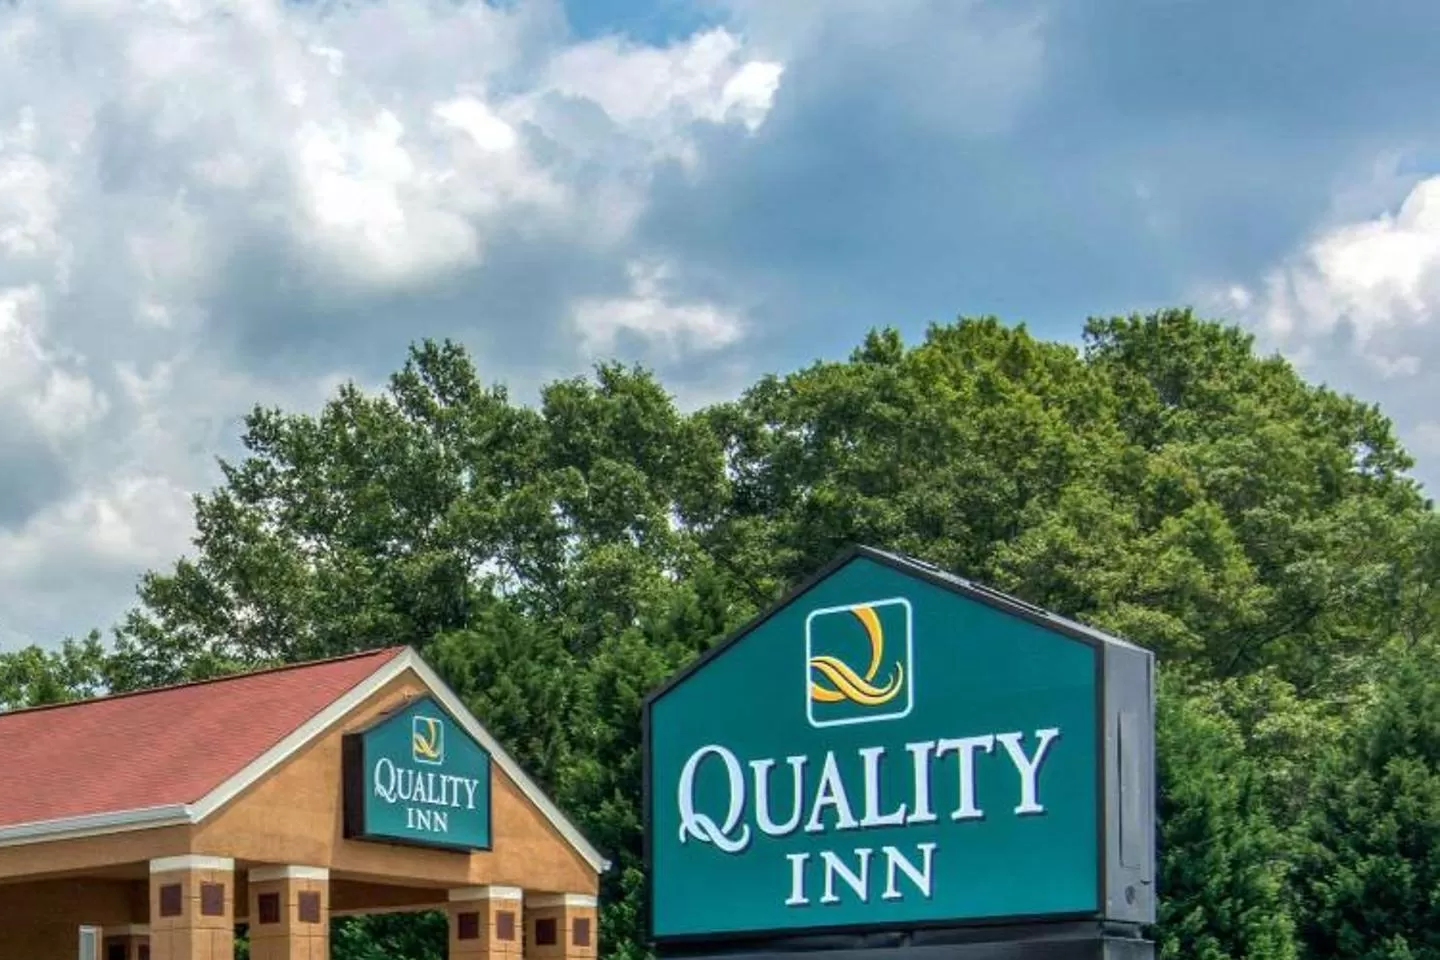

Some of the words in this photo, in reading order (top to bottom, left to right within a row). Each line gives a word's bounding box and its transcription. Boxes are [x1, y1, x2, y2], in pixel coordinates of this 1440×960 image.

[374, 757, 479, 809] QUALITY
[677, 727, 1059, 853] QUALITY
[406, 807, 449, 832] INN
[784, 842, 937, 906] INN
